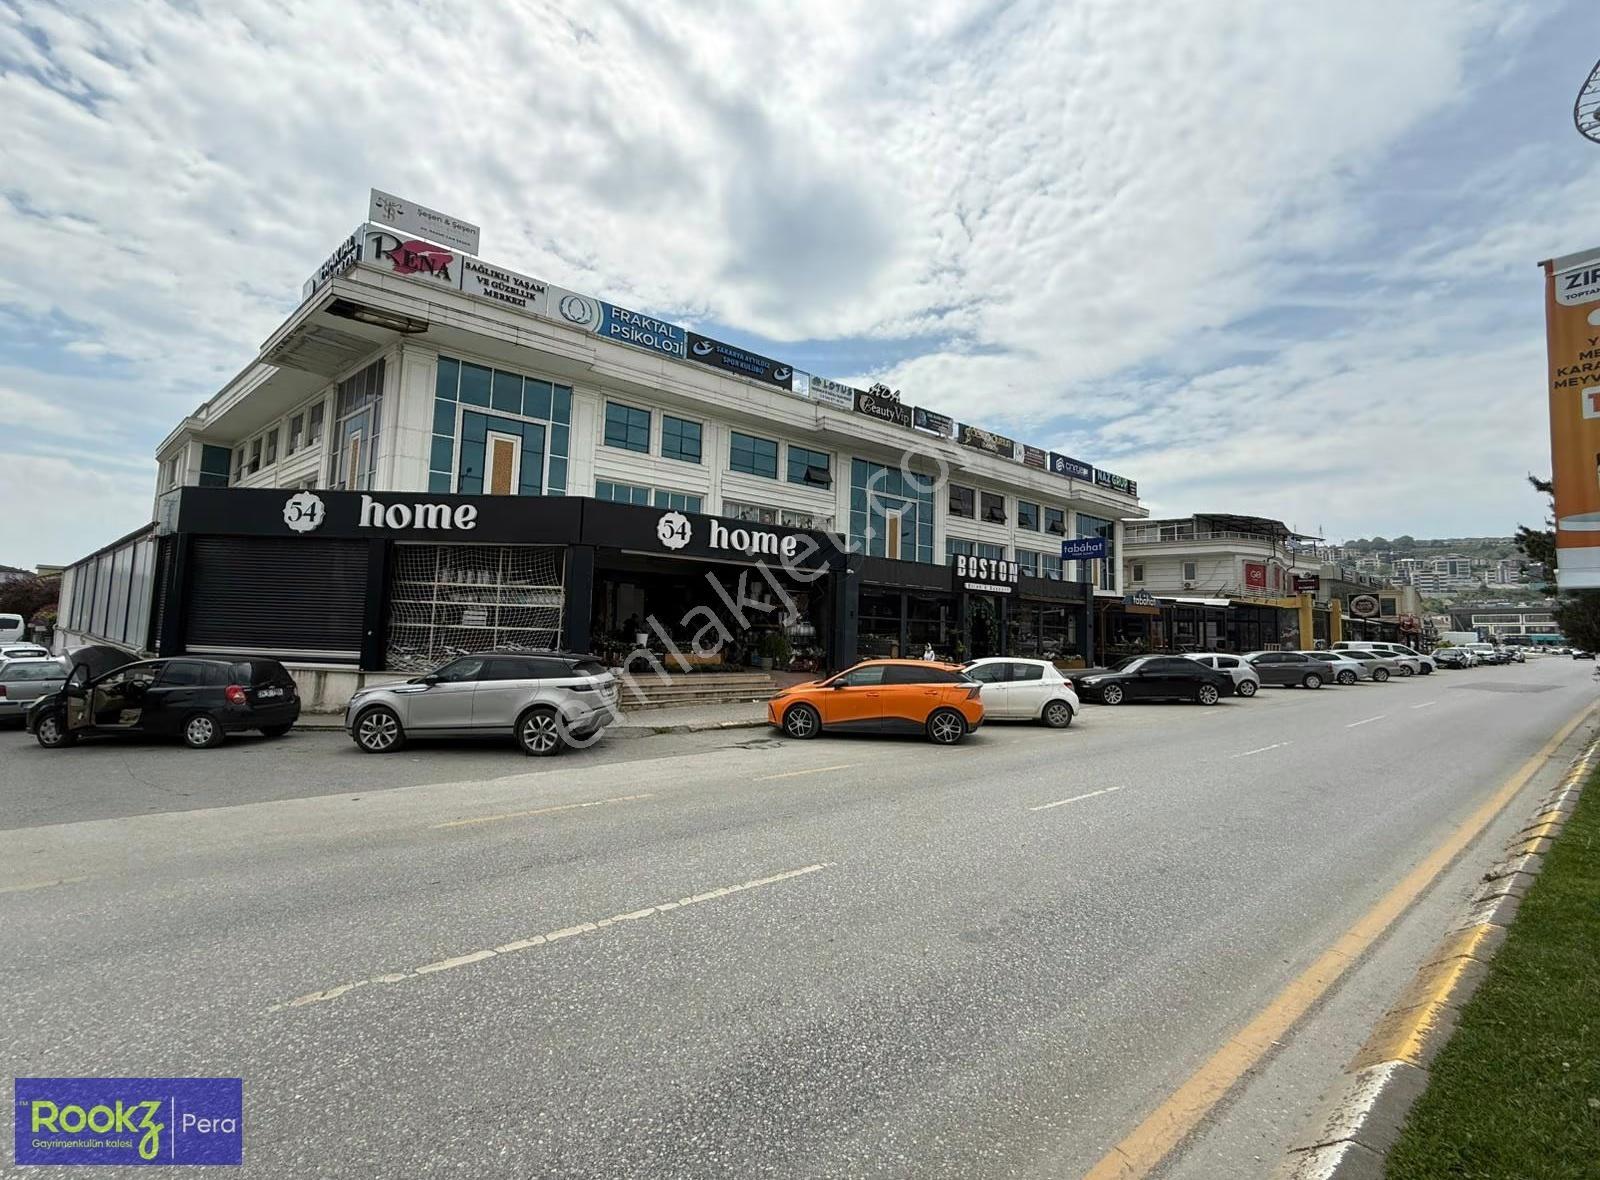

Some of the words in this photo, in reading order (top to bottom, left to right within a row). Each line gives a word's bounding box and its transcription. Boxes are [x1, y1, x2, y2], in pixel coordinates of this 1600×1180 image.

[365, 231, 452, 282] RENA
[465, 262, 510, 283] SAĞLIKLI
[513, 277, 545, 294] YAŞAM
[476, 275, 490, 286] VE
[611, 307, 677, 339] FRAKTAL
[610, 323, 683, 356] PSİKOLOJİ
[287, 501, 317, 523] 54
[358, 494, 478, 530] home
[661, 520, 688, 541] 54
[708, 519, 798, 557] home
[957, 554, 1018, 583] BOSTON
